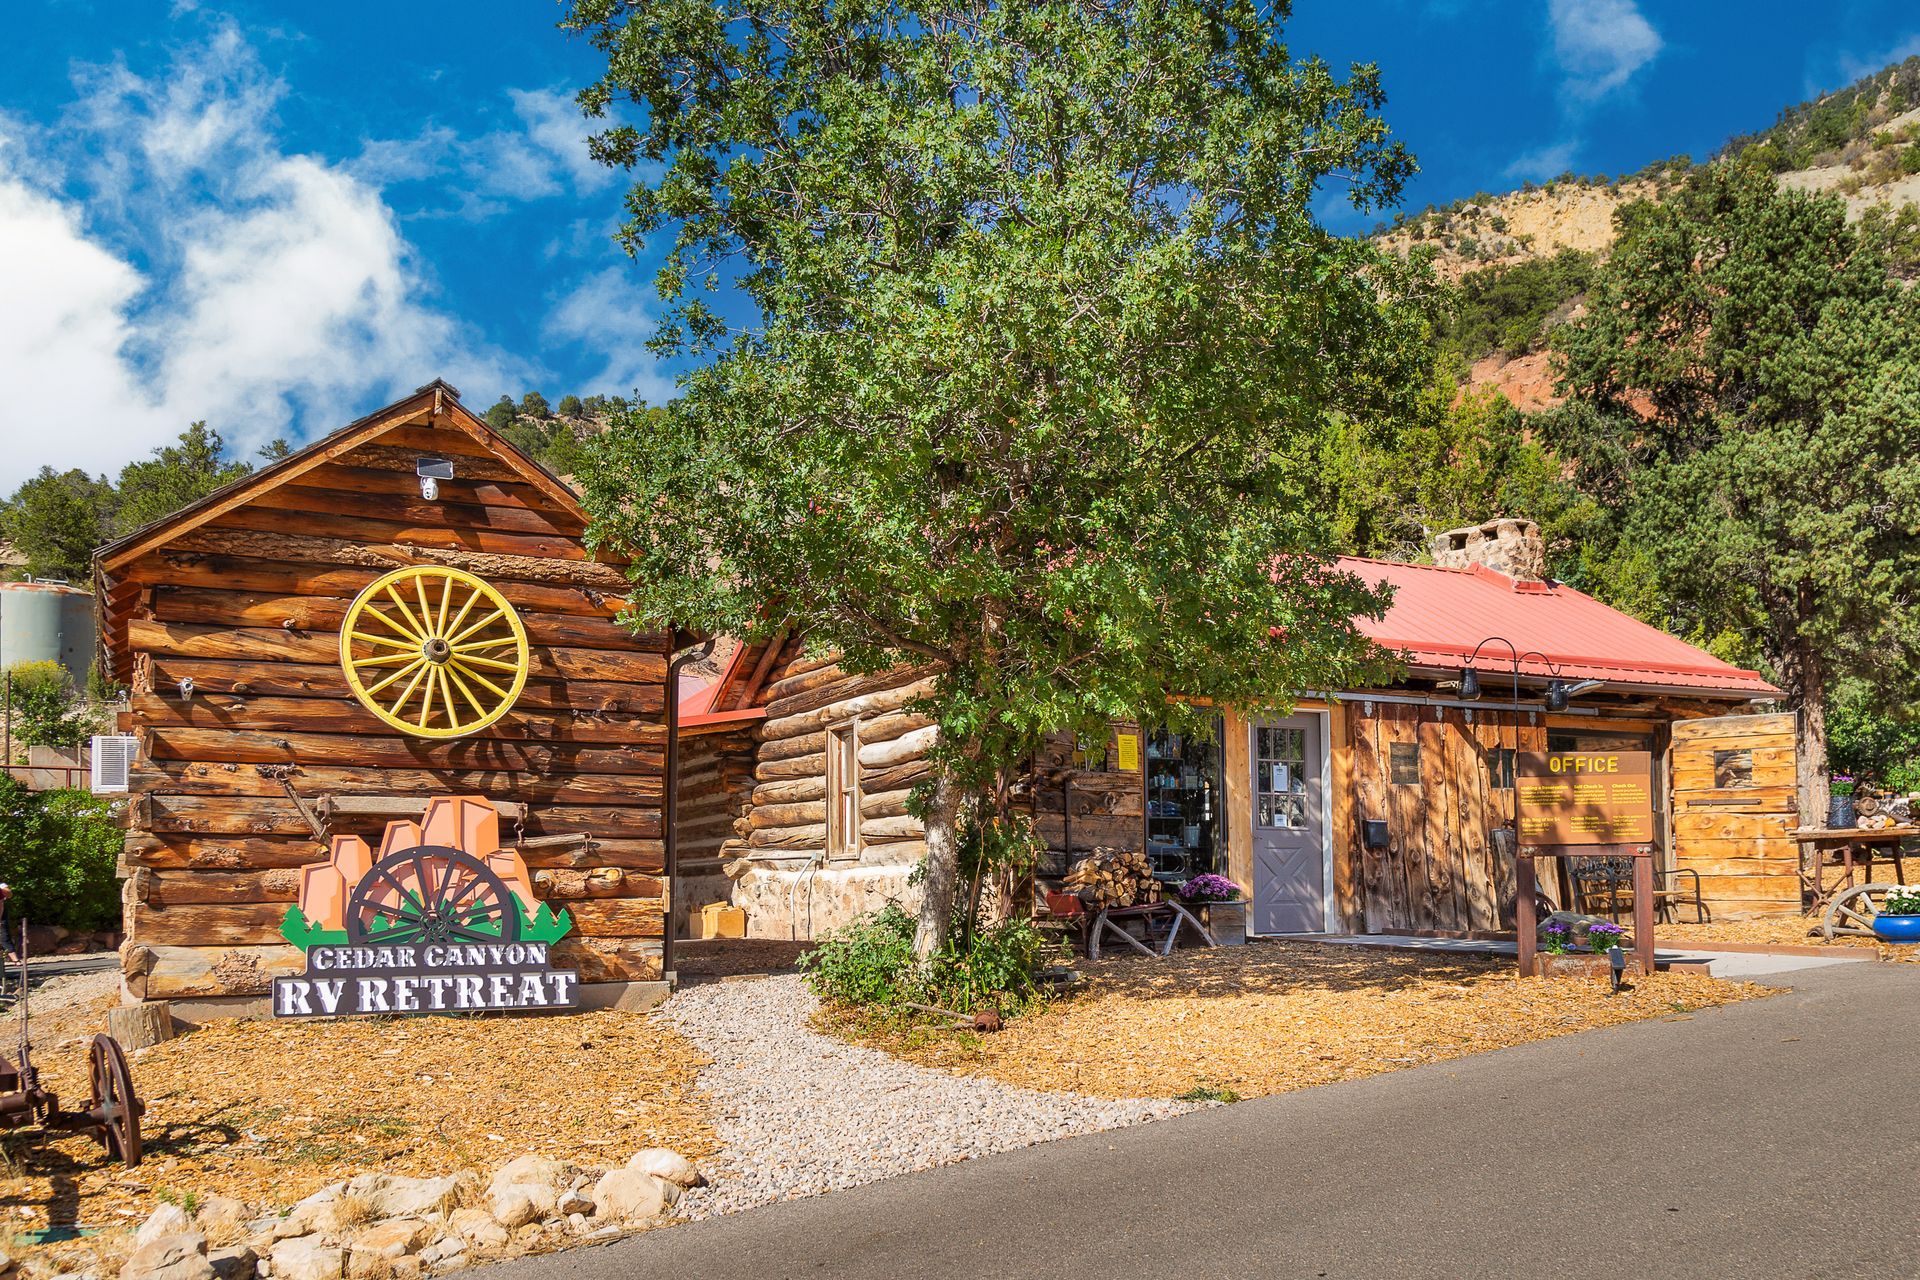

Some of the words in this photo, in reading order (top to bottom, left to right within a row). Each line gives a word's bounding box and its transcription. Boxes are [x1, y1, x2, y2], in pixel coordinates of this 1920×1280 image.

[1549, 756, 1619, 773] OFFICE
[312, 946, 417, 970] CEDAR
[423, 943, 547, 967] CANYON
[276, 977, 346, 1015] RV
[356, 971, 577, 1013] RETREAT
